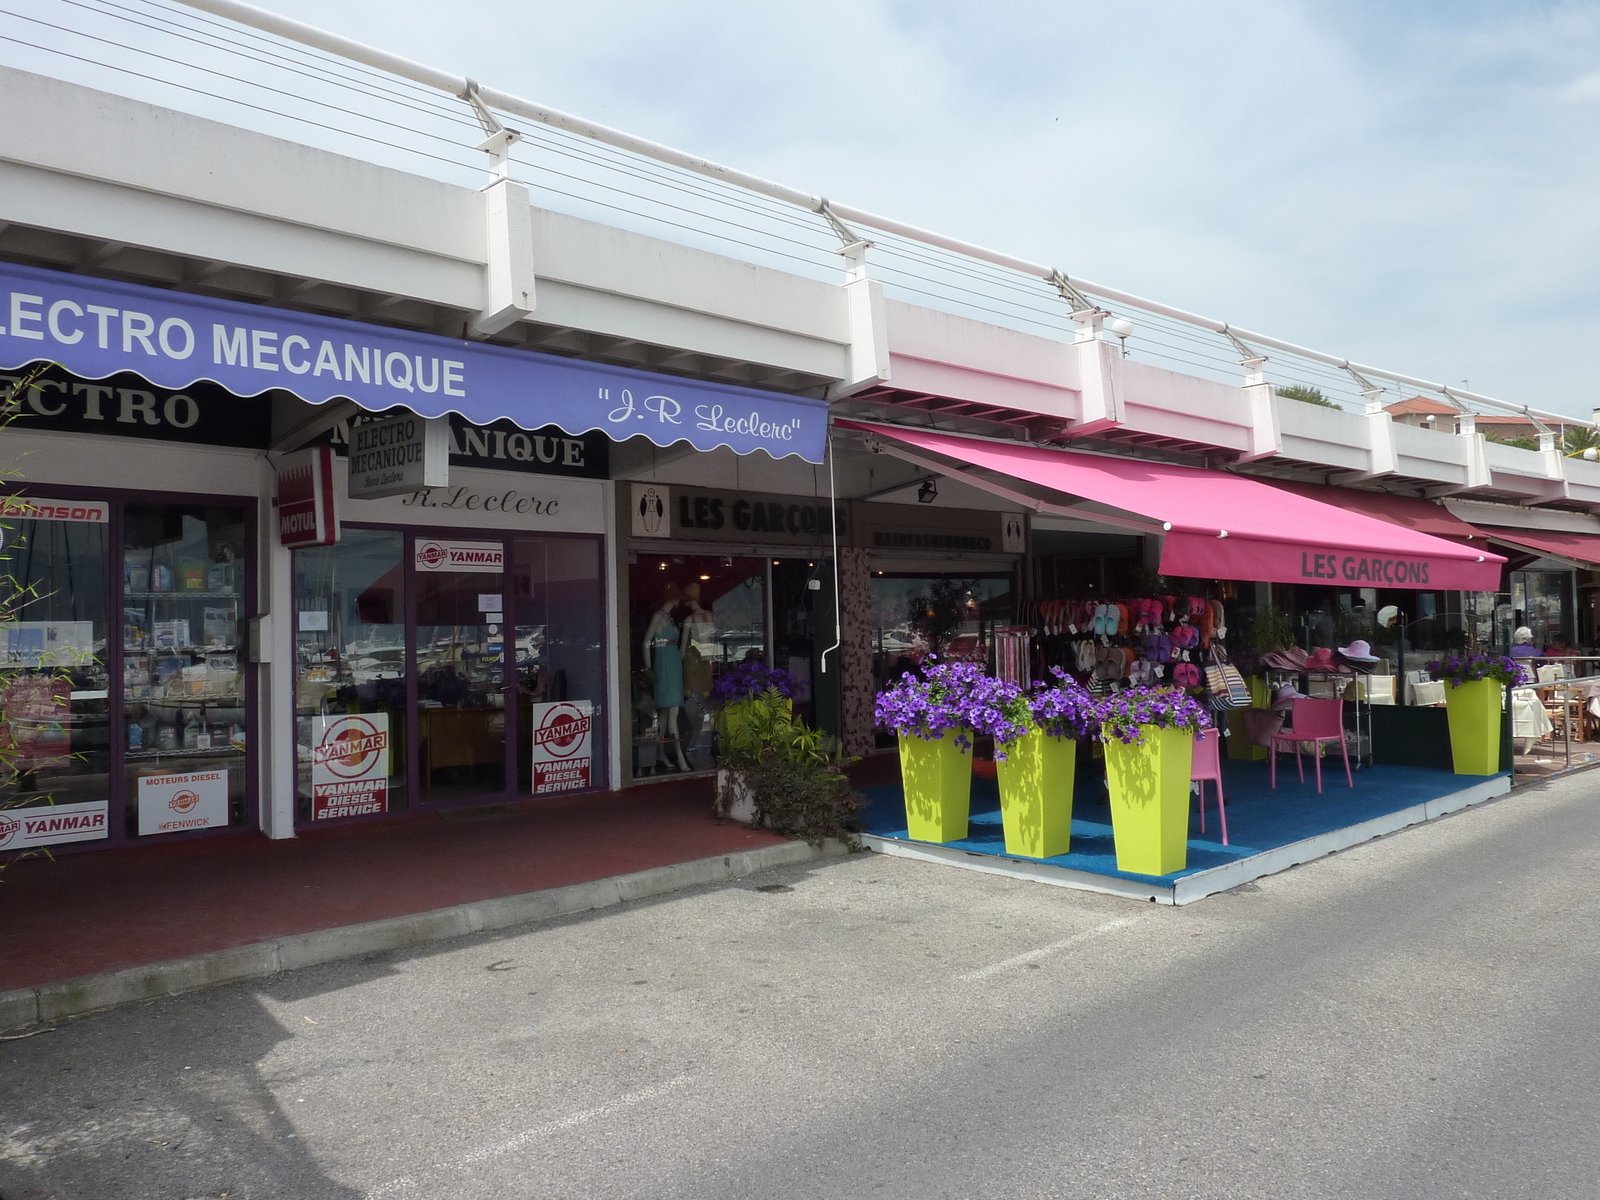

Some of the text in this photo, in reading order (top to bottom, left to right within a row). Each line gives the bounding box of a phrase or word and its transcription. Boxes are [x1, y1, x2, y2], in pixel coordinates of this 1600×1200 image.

[0, 291, 467, 398] ECTRO MECANIQUE
[356, 419, 415, 452] ELECTRO
[351, 442, 422, 475] MECANIQUE
[380, 471, 404, 485] Leclerc
[281, 511, 316, 535] MOTUL
[679, 495, 847, 537] LES GARÇONS
[417, 550, 503, 563] YANMAR YANMAR
[1301, 552, 1430, 586] LES GARÇONS
[536, 720, 589, 742] YANMAR
[319, 735, 383, 761] YANMAR
[535, 758, 589, 774] YANMAR
[145, 773, 221, 786] MOTEURS DIESEL
[544, 769, 582, 783] DIESEL
[315, 779, 386, 796] YANMAR
[536, 779, 586, 793] SERVICE
[327, 791, 376, 807] DIESEL
[317, 803, 381, 820] SERVICE
[24, 814, 105, 834] YANMAR
[166, 817, 210, 830] FENWICK
